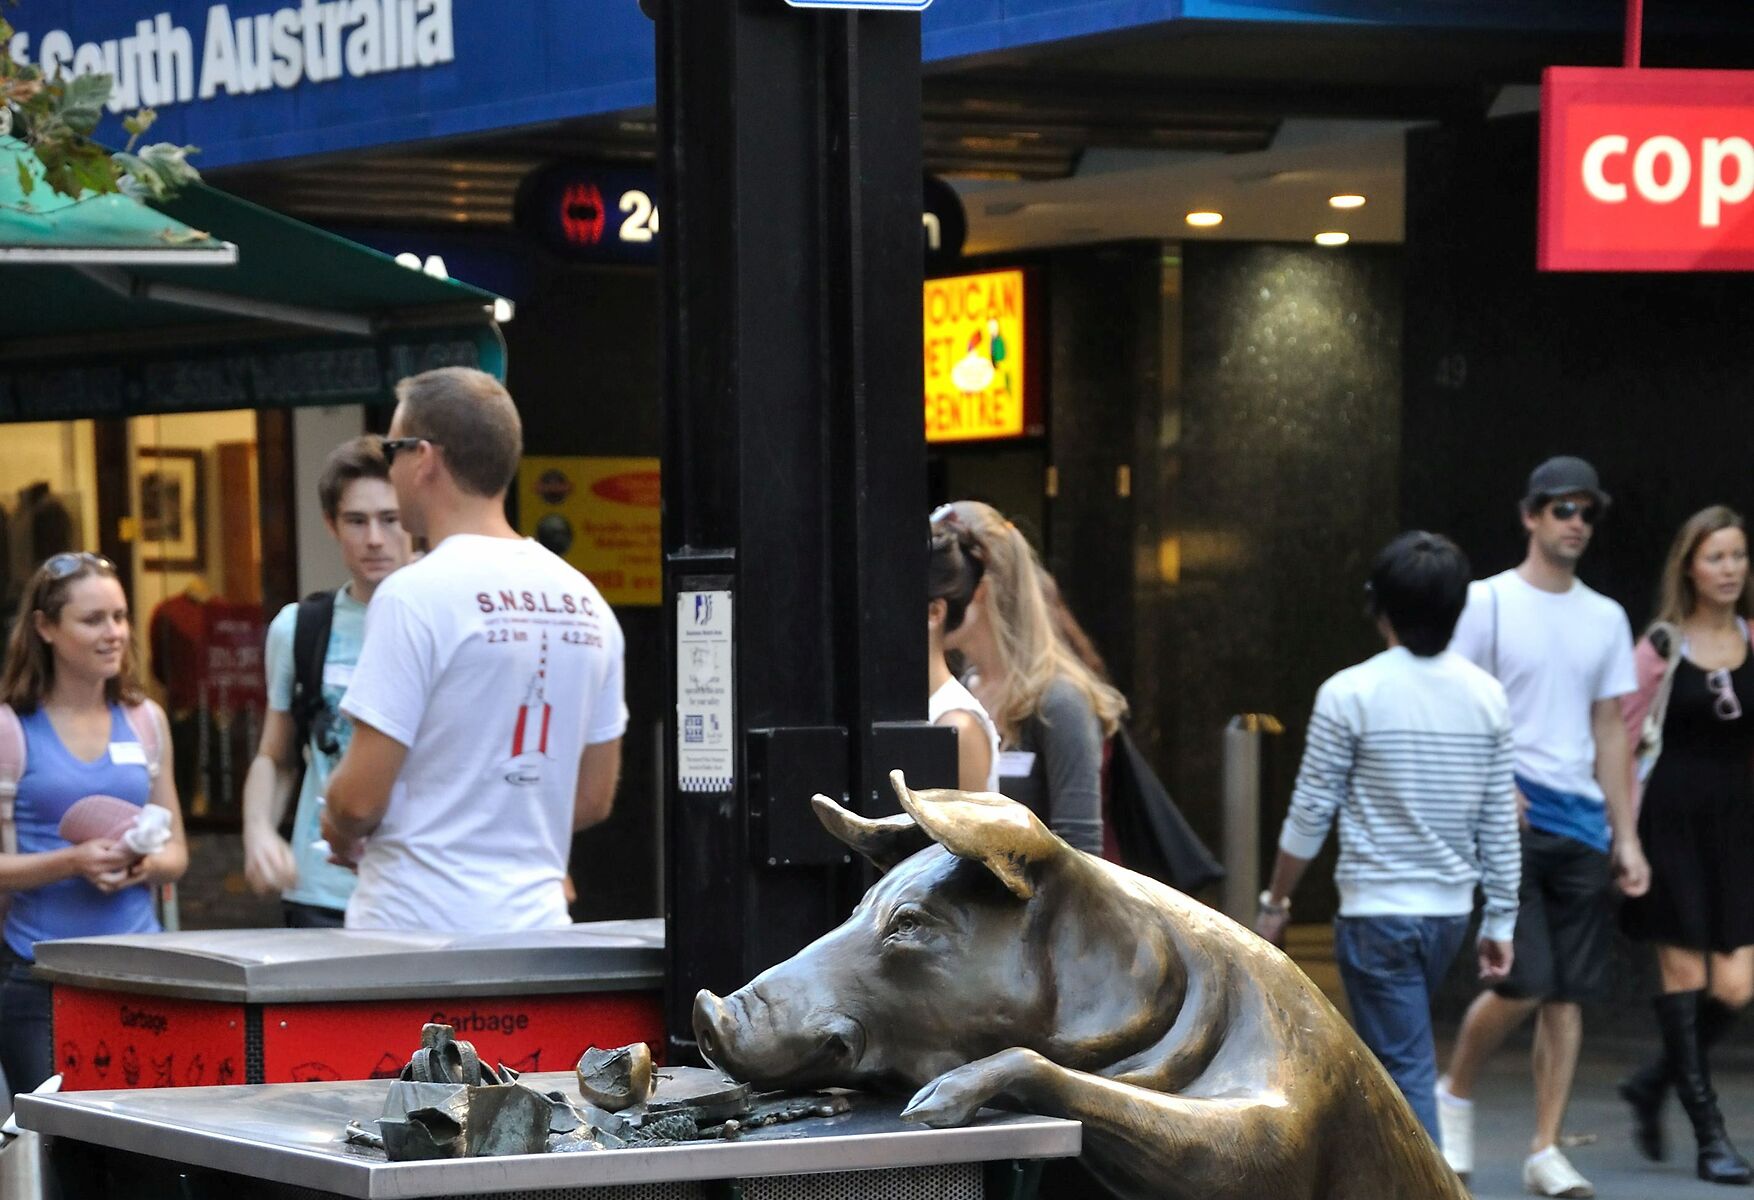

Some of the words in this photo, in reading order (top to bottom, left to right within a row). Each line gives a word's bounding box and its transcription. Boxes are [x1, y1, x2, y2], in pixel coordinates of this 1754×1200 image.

[198, 0, 454, 98] Australia
[1581, 135, 1754, 227] cop
[929, 281, 1016, 326] OUCAN
[925, 338, 953, 378] ET
